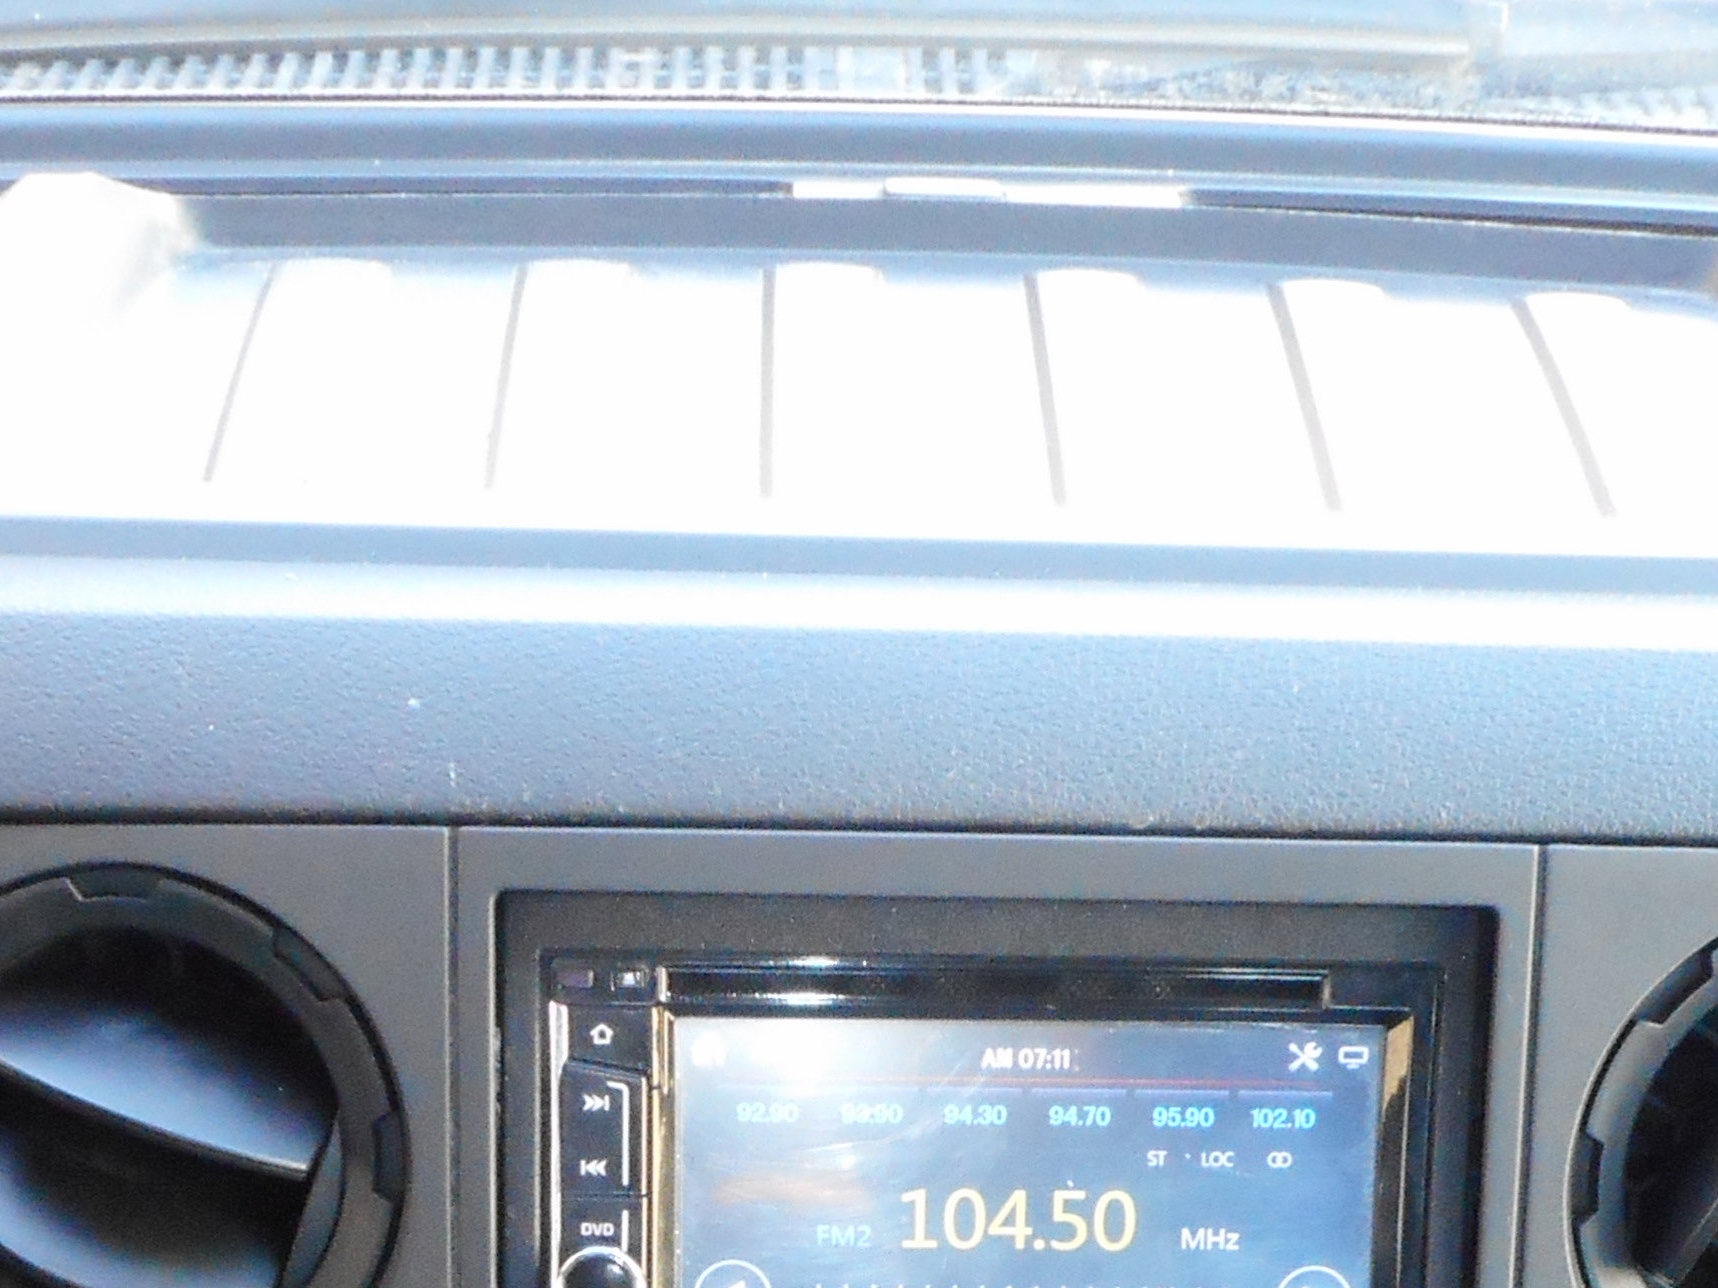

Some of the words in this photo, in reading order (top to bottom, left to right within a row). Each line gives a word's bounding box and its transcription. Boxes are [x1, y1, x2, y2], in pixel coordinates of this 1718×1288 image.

[981, 1048, 1013, 1069] AM
[1018, 1048, 1072, 1070] 07:11
[737, 1102, 799, 1124] 92.90
[944, 1103, 1008, 1126] 94.30
[1048, 1105, 1112, 1127] 94.70
[1152, 1106, 1215, 1128] 95.90
[1251, 1107, 1317, 1129] 102.10
[1147, 1150, 1169, 1168] ST
[1201, 1150, 1235, 1168] LOC
[580, 1222, 615, 1237] DVD
[899, 1187, 1138, 1253] 104.50
[1180, 1227, 1240, 1252] MHz
[816, 1224, 871, 1248] FM2
